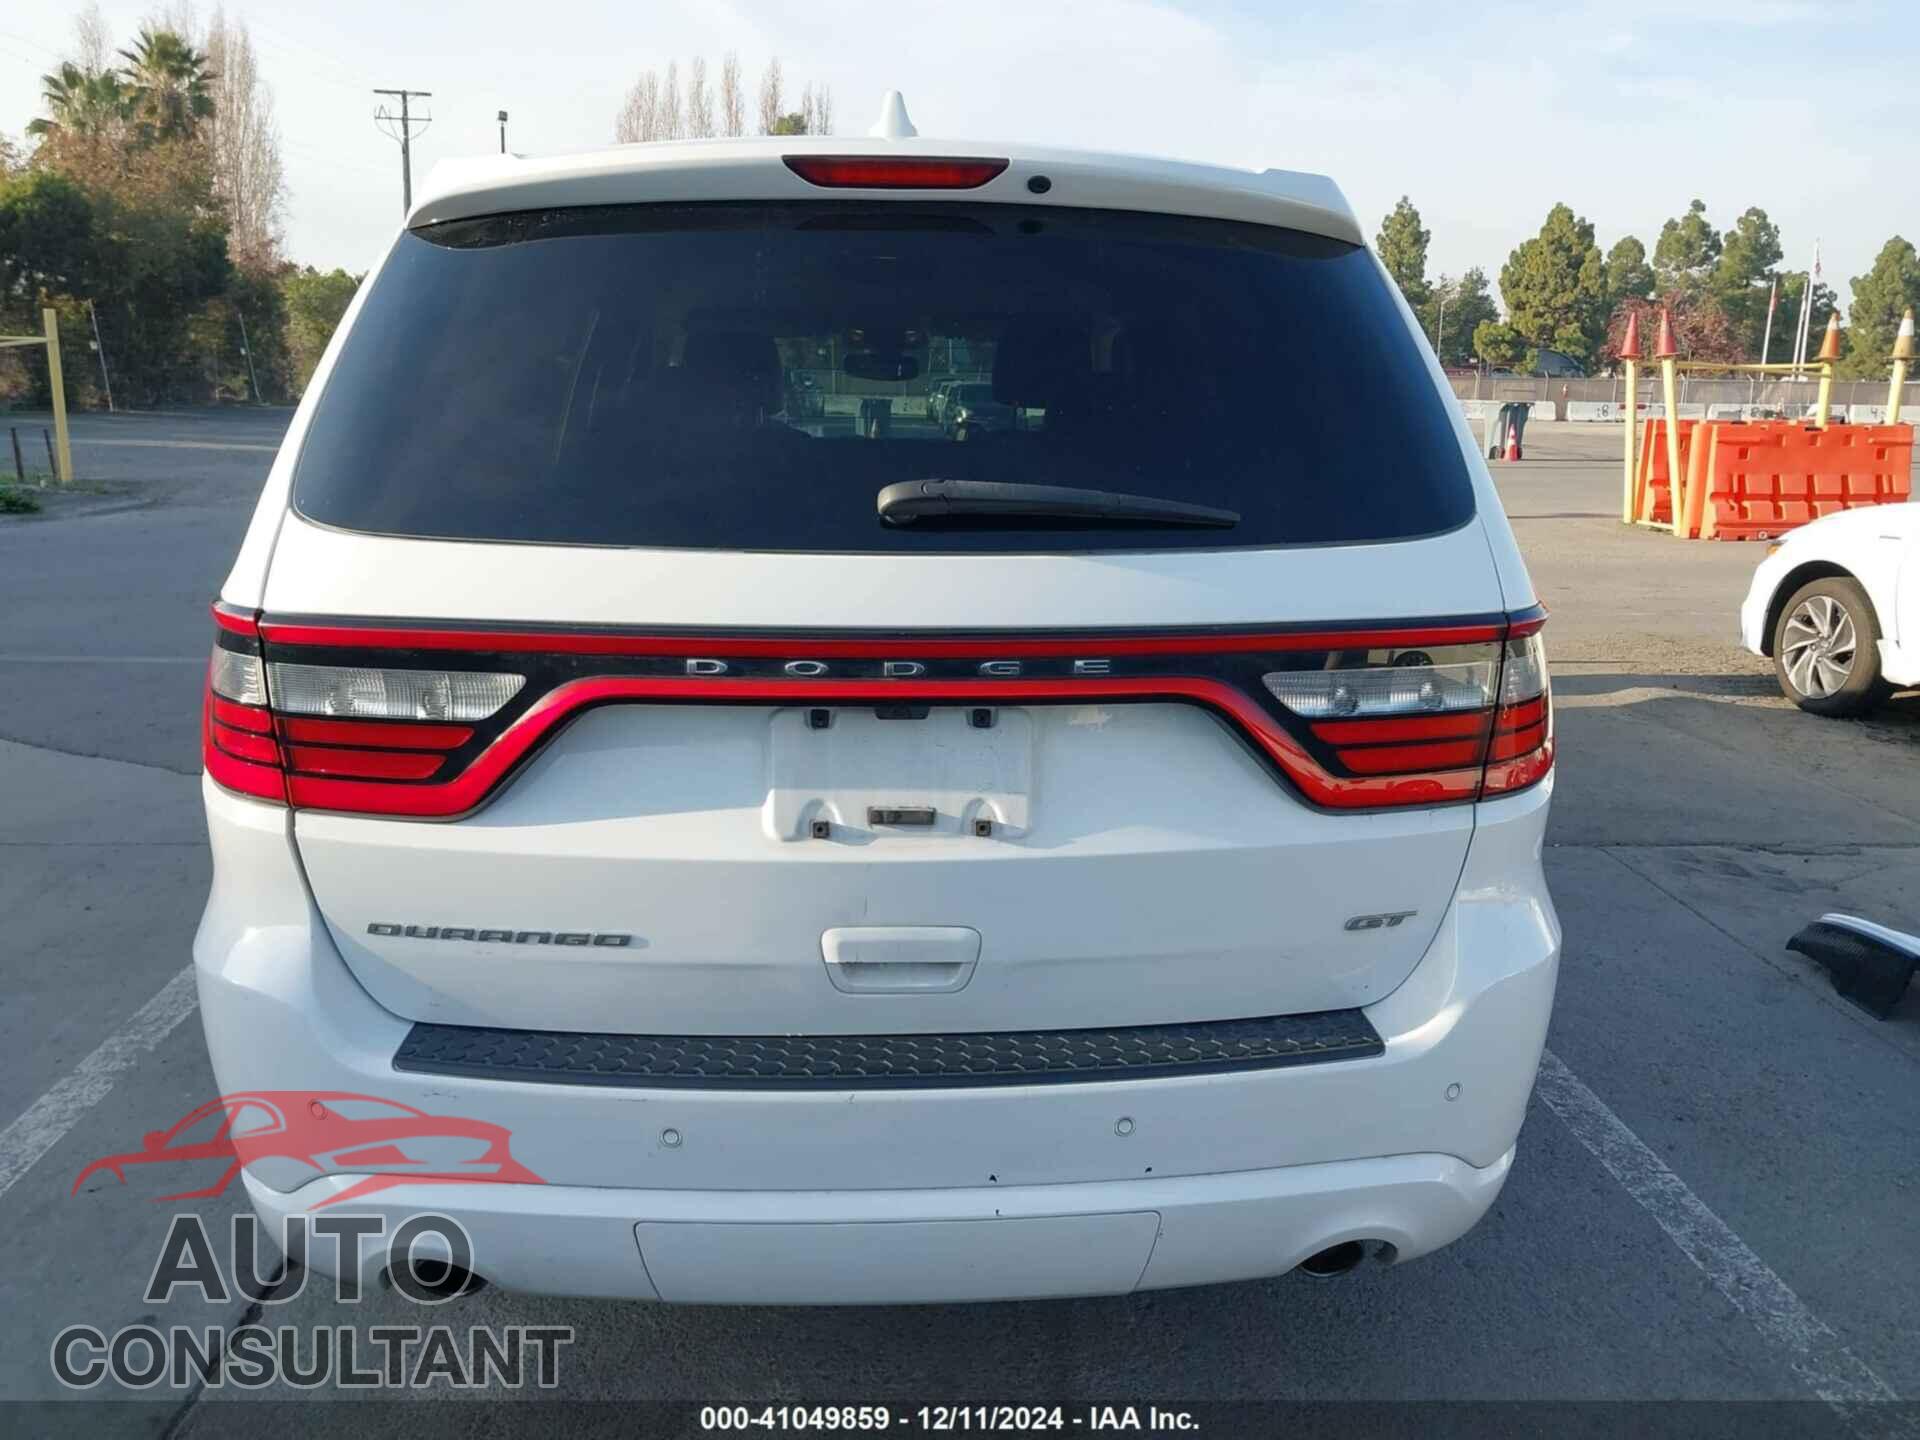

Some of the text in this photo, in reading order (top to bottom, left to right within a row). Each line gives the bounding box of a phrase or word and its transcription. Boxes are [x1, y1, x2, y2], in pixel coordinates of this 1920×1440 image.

[685, 658, 1112, 677] DODGE
[1344, 910, 1418, 931] GT
[366, 921, 634, 948] DURANGO
